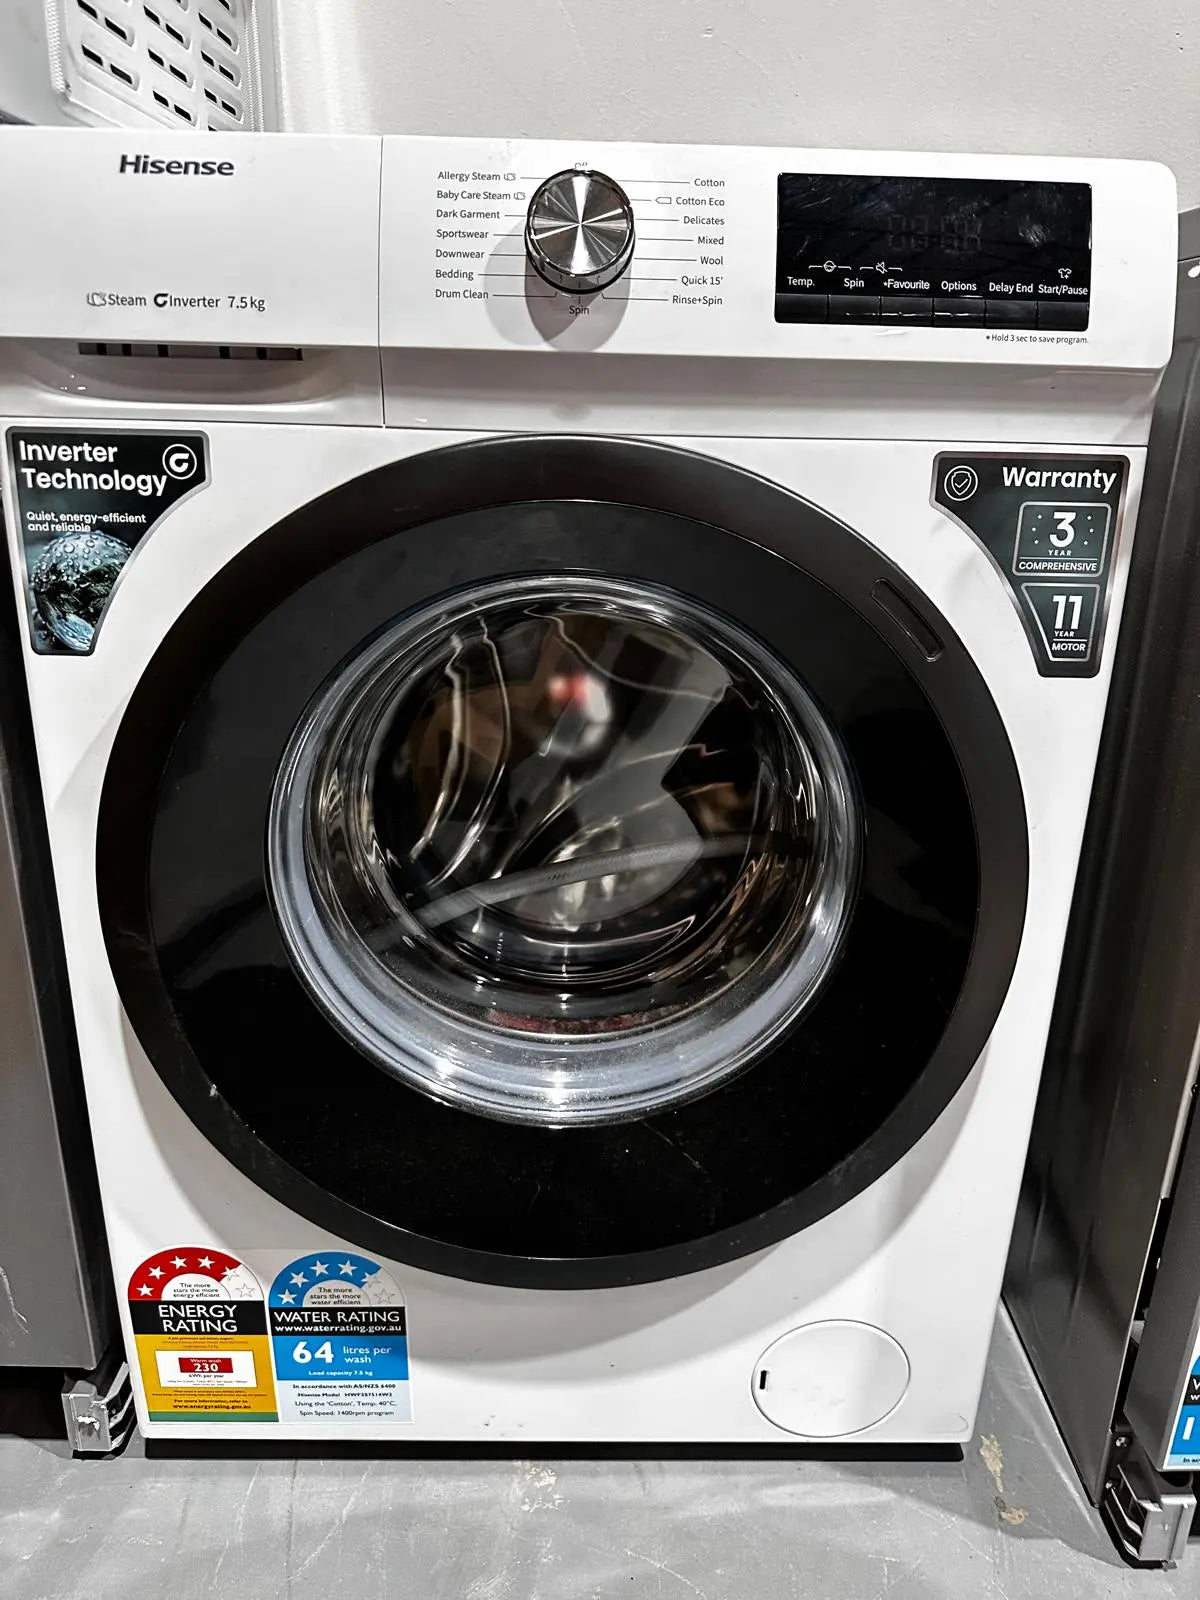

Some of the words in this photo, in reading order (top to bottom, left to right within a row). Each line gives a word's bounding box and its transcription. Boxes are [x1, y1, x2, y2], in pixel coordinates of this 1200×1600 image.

[119, 154, 235, 176] Hisense
[437, 171, 470, 181] Allergy
[472, 172, 501, 181] Steam
[694, 179, 725, 187] Cotton
[437, 190, 460, 201] Baby
[461, 191, 481, 200] Care
[482, 191, 511, 200] Steam
[675, 197, 707, 206] Cotton
[709, 197, 725, 207] Eco
[436, 209, 458, 219] Dark
[459, 209, 500, 219] Garment
[683, 216, 725, 225] Delicates
[436, 228, 489, 240] Sportswear
[697, 236, 725, 245] Mixed
[435, 249, 485, 259] Downwear
[700, 256, 724, 265] Wool
[435, 269, 474, 281] Bedding
[681, 275, 708, 286] Quick
[787, 277, 815, 288] Temp.
[844, 277, 865, 289] Spin
[941, 280, 977, 292] Options
[435, 288, 461, 298] Drum
[462, 289, 489, 299] Clean
[989, 282, 1015, 295] Delay
[1016, 283, 1034, 293] End
[1038, 284, 1089, 296] Start/Pause
[108, 293, 147, 306] Steam
[250, 296, 266, 312] kg
[672, 295, 723, 307] Rinse+Spin
[569, 305, 590, 316] Spin
[991, 334, 1009, 342] Hold
[1010, 334, 1015, 342] 3
[1029, 335, 1038, 343] to
[19, 440, 118, 463] Inverter
[20, 468, 167, 497] Technology
[1002, 466, 1117, 494] Warranty
[26, 511, 59, 523] Quiet,
[59, 512, 146, 524] energy-efficient
[27, 523, 50, 532] and
[51, 523, 91, 532] reliable
[1049, 511, 1077, 548] 3
[1048, 549, 1072, 557] YEAR
[1018, 561, 1098, 571] COMPREHENSIVE
[1052, 595, 1083, 630] 11
[1054, 630, 1075, 638] YEAR
[1052, 642, 1086, 652] MOTOR
[158, 1304, 238, 1318] ENERGY
[273, 1311, 332, 1323] WATER
[337, 1311, 400, 1323] RATING
[162, 1319, 238, 1333] RATING
[274, 1324, 402, 1333] www.waterrating.gov.au
[292, 1341, 335, 1364] 64
[343, 1345, 370, 1355] litres
[373, 1347, 392, 1356] per
[344, 1355, 372, 1364] wash
[193, 1363, 219, 1372] 230
